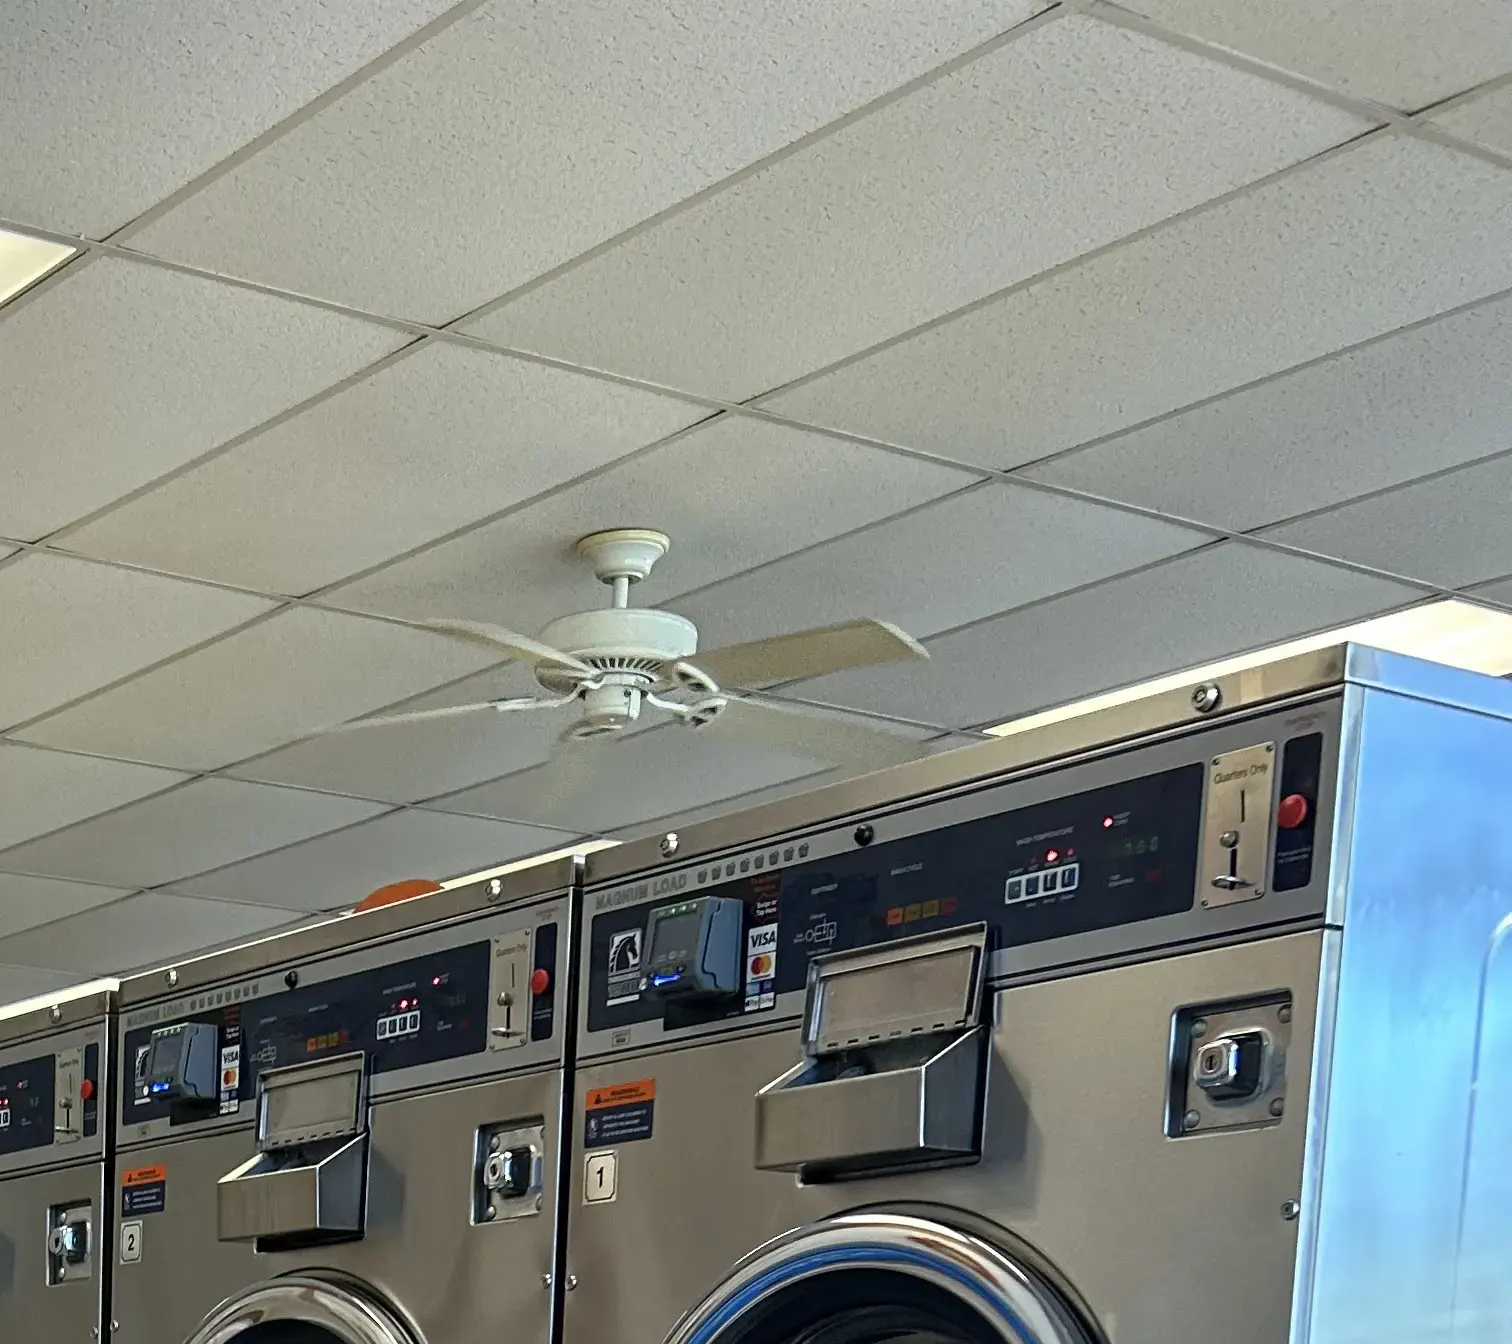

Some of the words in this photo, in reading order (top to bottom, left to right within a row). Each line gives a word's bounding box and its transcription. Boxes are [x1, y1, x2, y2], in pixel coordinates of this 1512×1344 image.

[1214, 766, 1248, 785] Quarters
[1249, 762, 1269, 776] Only
[595, 884, 649, 910] MAGNUM
[652, 873, 687, 896] LOAD
[750, 930, 777, 948] VISA
[596, 1166, 605, 1189] 1
[127, 1233, 135, 1252] 2
